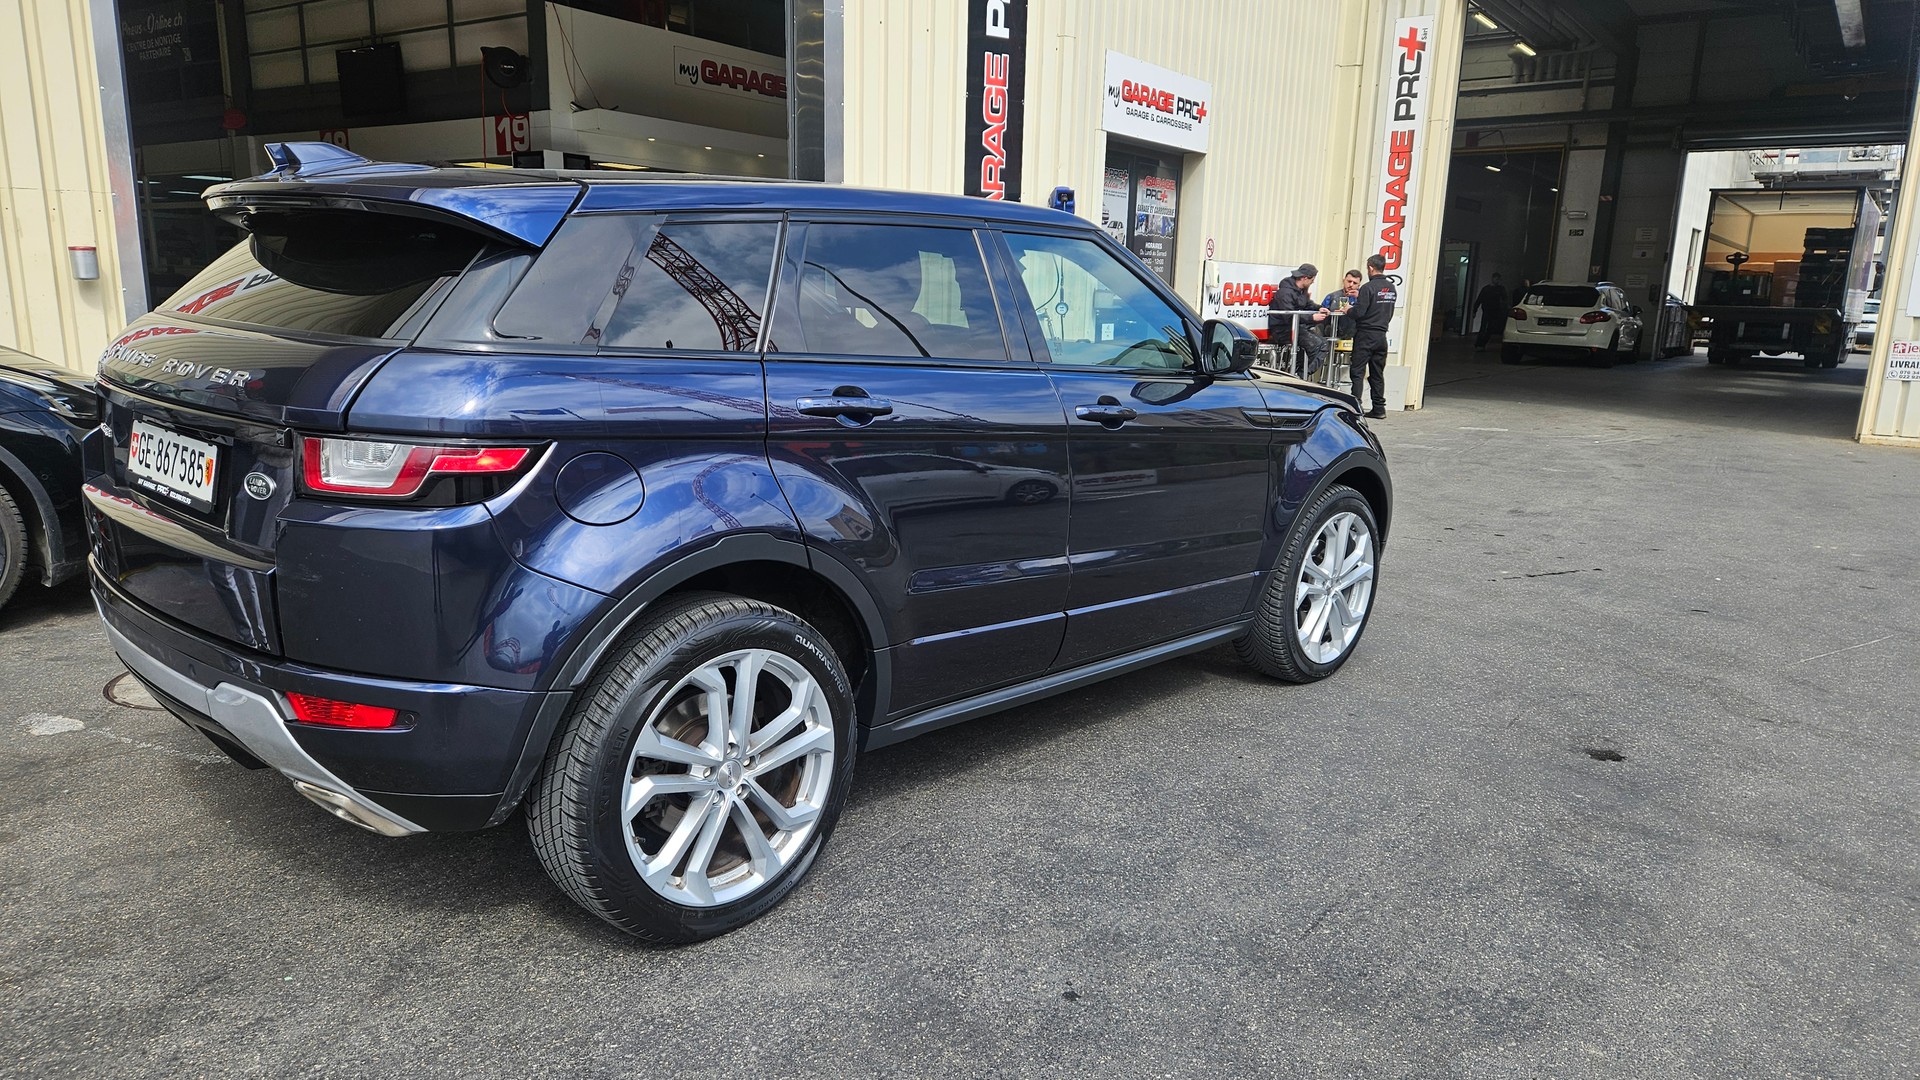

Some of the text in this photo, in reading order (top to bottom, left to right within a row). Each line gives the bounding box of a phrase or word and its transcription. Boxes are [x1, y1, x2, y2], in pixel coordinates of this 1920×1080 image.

[679, 59, 787, 99] my GARAGE
[1108, 85, 1121, 108] my
[1122, 79, 1175, 114] GARAGE
[981, 52, 1010, 200] RAGE
[1126, 107, 1193, 131] GARAGE & CARROSSERIE
[498, 117, 529, 151] 19
[1379, 129, 1415, 270] GARAGE
[1208, 291, 1221, 315] my
[1227, 309, 1251, 318] GARAGE
[1252, 309, 1257, 318] &
[1907, 343, 1920, 353] je
[110, 343, 251, 388] RANGE ROVER
[1890, 360, 1920, 369] LIVRAI
[249, 477, 263, 487] LAND
[250, 484, 267, 496] ROVER
[795, 634, 833, 671] QUATRAC
